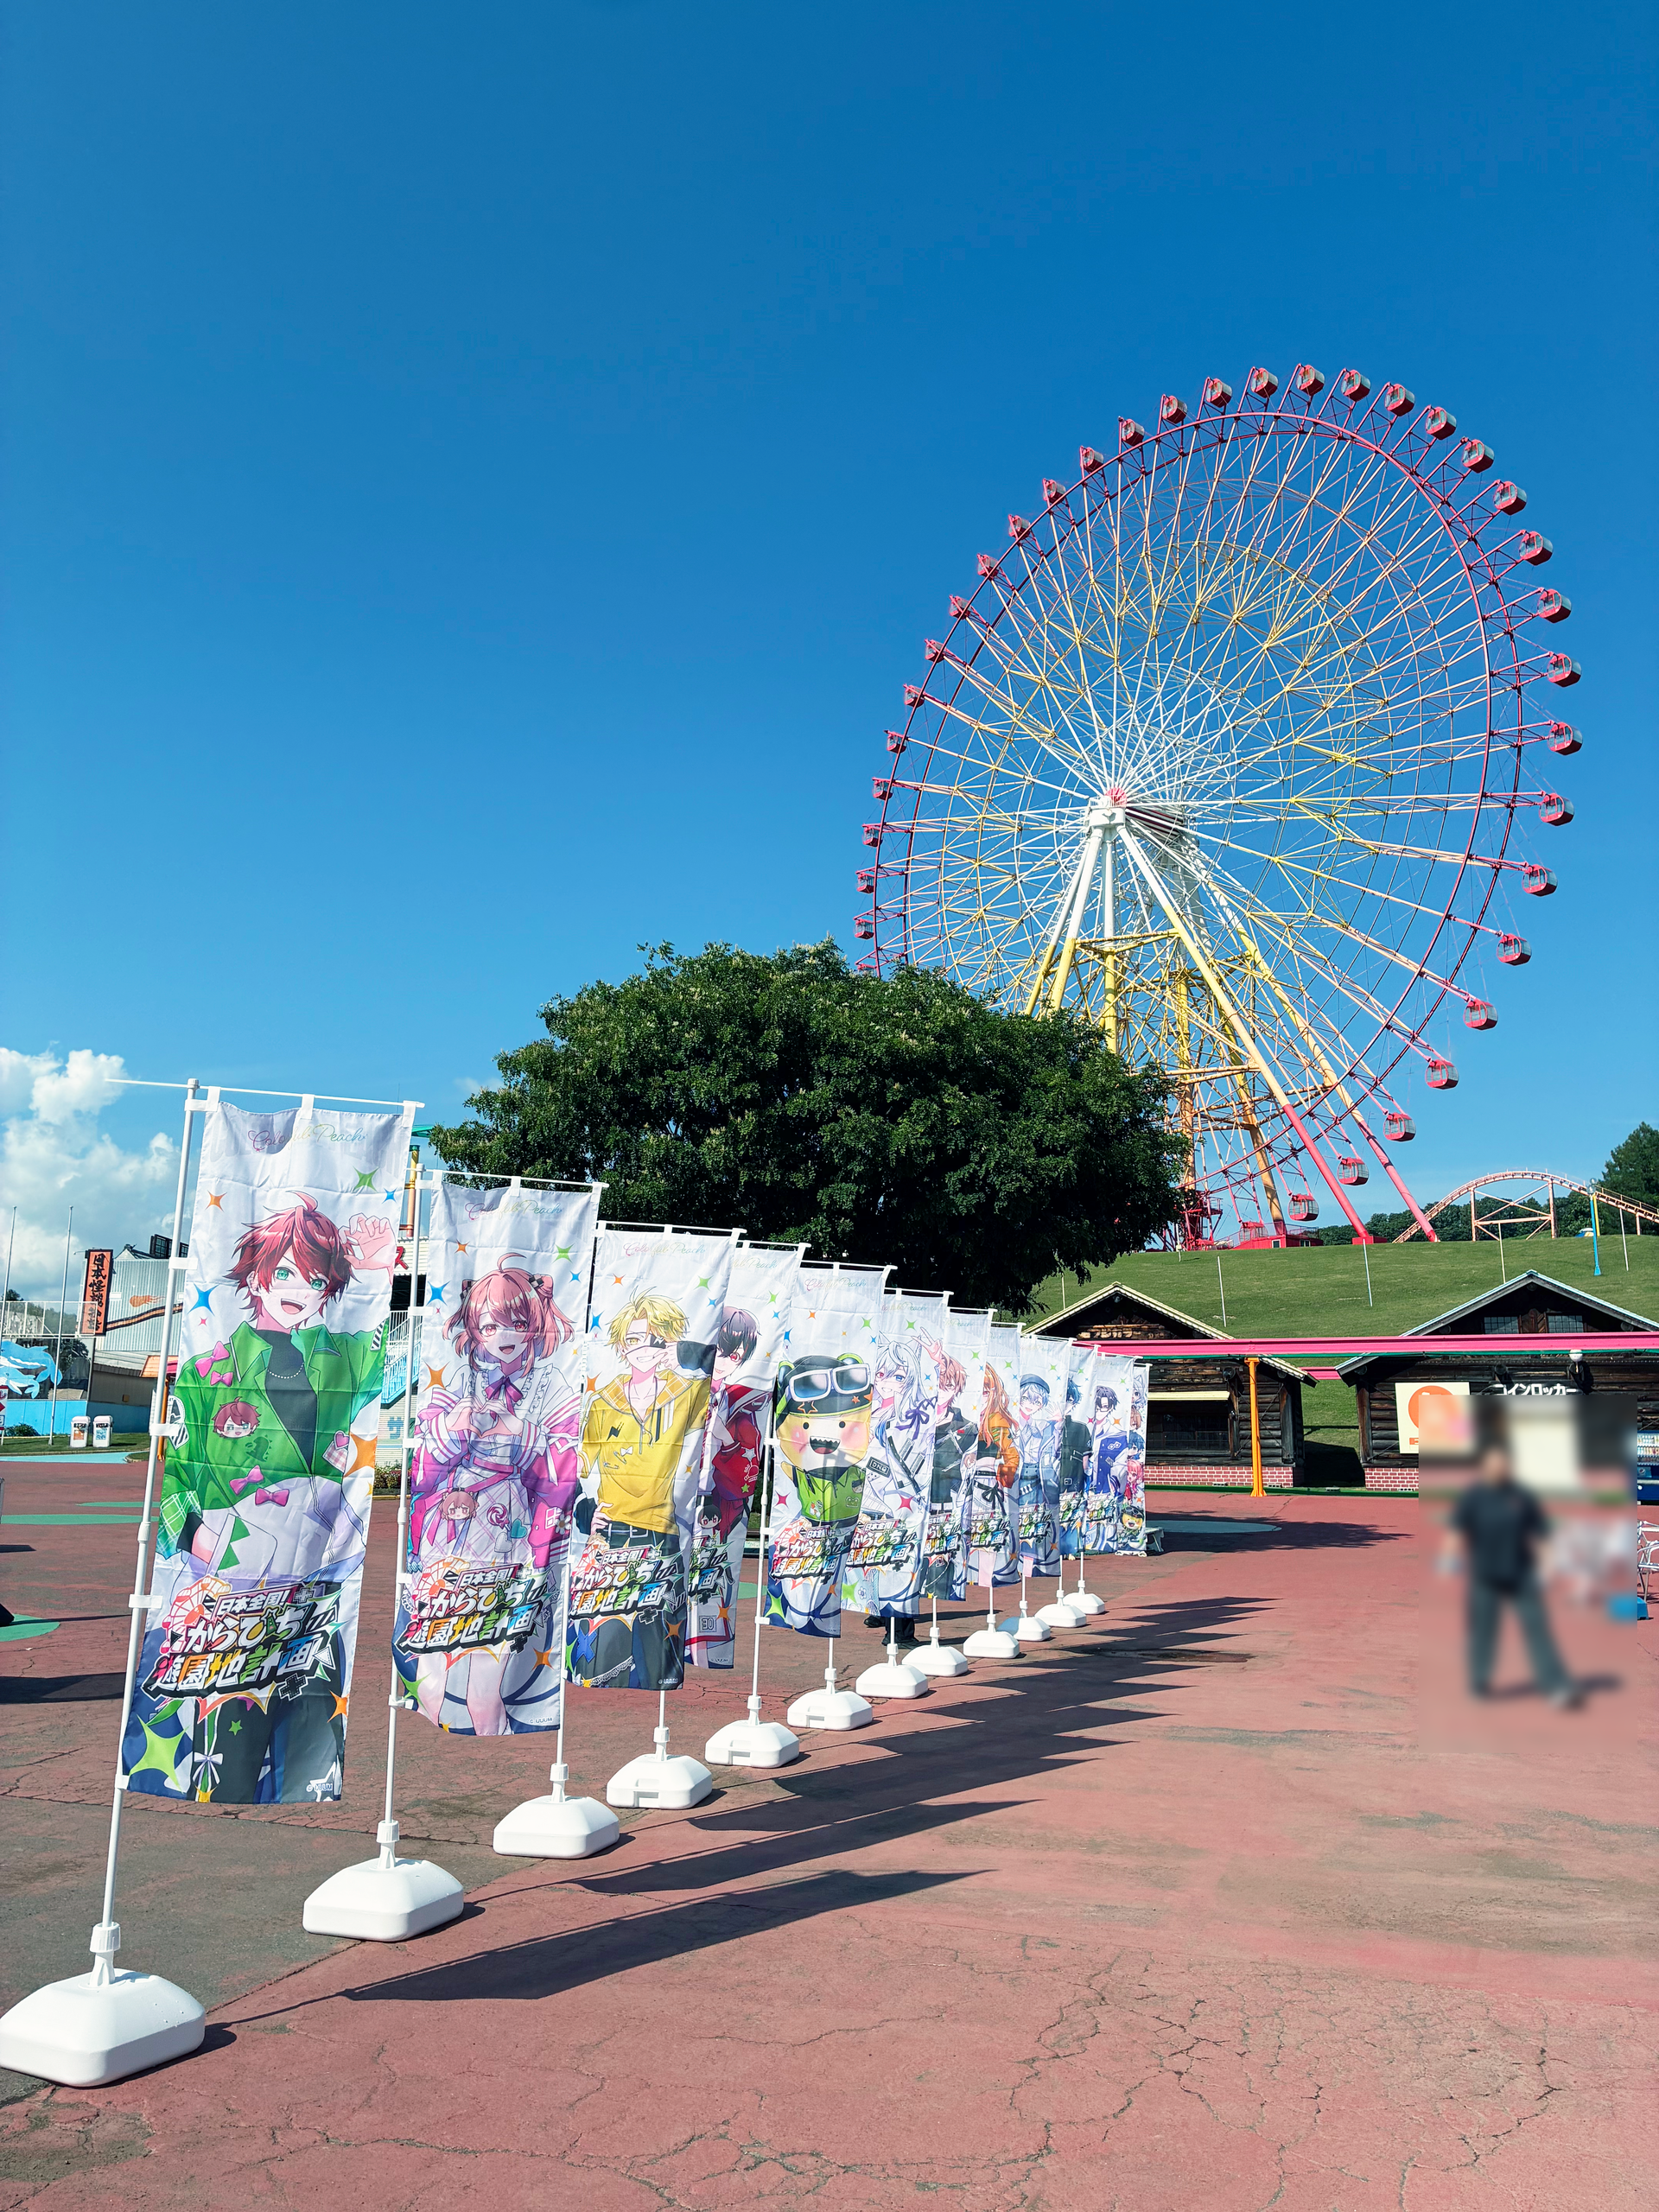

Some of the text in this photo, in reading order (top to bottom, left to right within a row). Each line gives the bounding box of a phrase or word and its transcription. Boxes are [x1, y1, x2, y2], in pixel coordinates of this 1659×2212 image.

[313, 1123, 366, 1143] Peach
[520, 1199, 562, 1214] Peach
[670, 1242, 706, 1254] Peach
[1493, 1382, 1577, 1395] コインロッカー
[461, 1567, 513, 1587] 日本全国!
[582, 1560, 658, 1590] からぴち
[218, 1590, 287, 1615] 日本全国!
[430, 1579, 531, 1618] からぴち
[186, 1606, 311, 1653] からぴち
[400, 1605, 540, 1649] 遊園地計画
[152, 1635, 323, 1690] 遊園地計画
